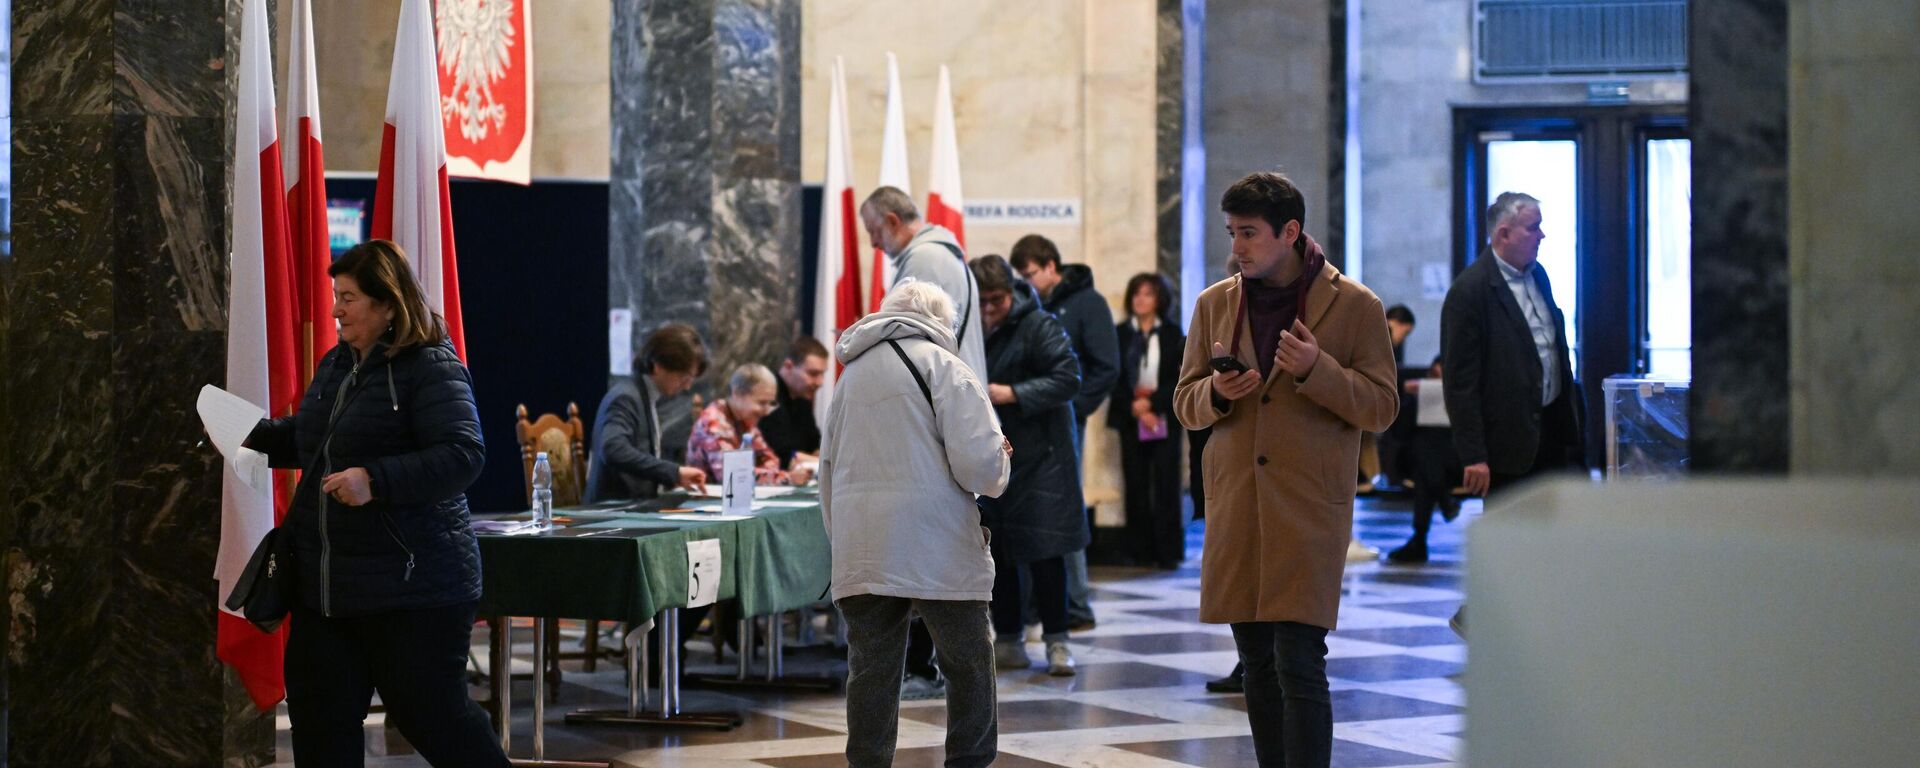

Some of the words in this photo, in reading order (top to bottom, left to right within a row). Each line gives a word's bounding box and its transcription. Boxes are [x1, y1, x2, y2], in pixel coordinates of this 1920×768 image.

[1007, 204, 1074, 218] RODZICA
[725, 471, 734, 509] 4
[690, 561, 701, 601] 5
